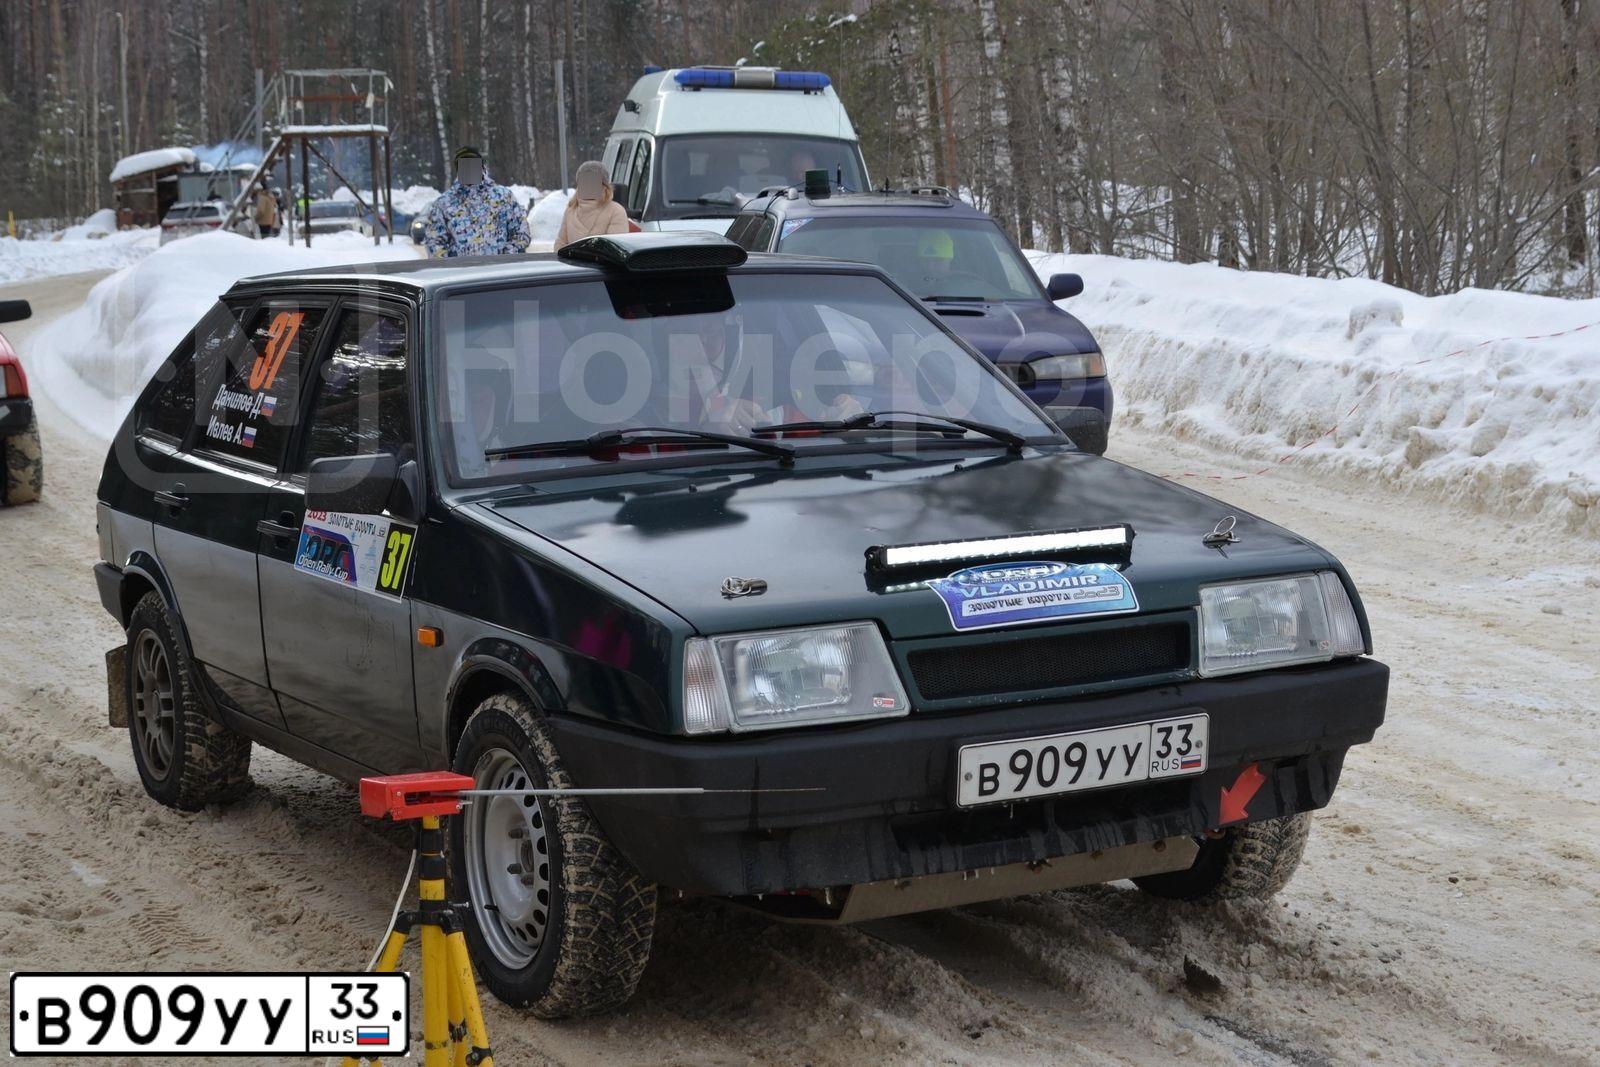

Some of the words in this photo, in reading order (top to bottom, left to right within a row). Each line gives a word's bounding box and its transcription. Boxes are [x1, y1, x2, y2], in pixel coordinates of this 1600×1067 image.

[249, 311, 305, 390] 37
[206, 414, 233, 443] Ивлев
[232, 421, 244, 446] А.
[298, 554, 317, 572] Open
[316, 559, 335, 576] Rally
[334, 566, 349, 582] Cup
[380, 530, 412, 590] 37
[958, 574, 1100, 598] VLADIMIR
[977, 741, 1144, 798] В909УУ
[1155, 722, 1194, 759] 33
[1151, 758, 1180, 773] RUS
